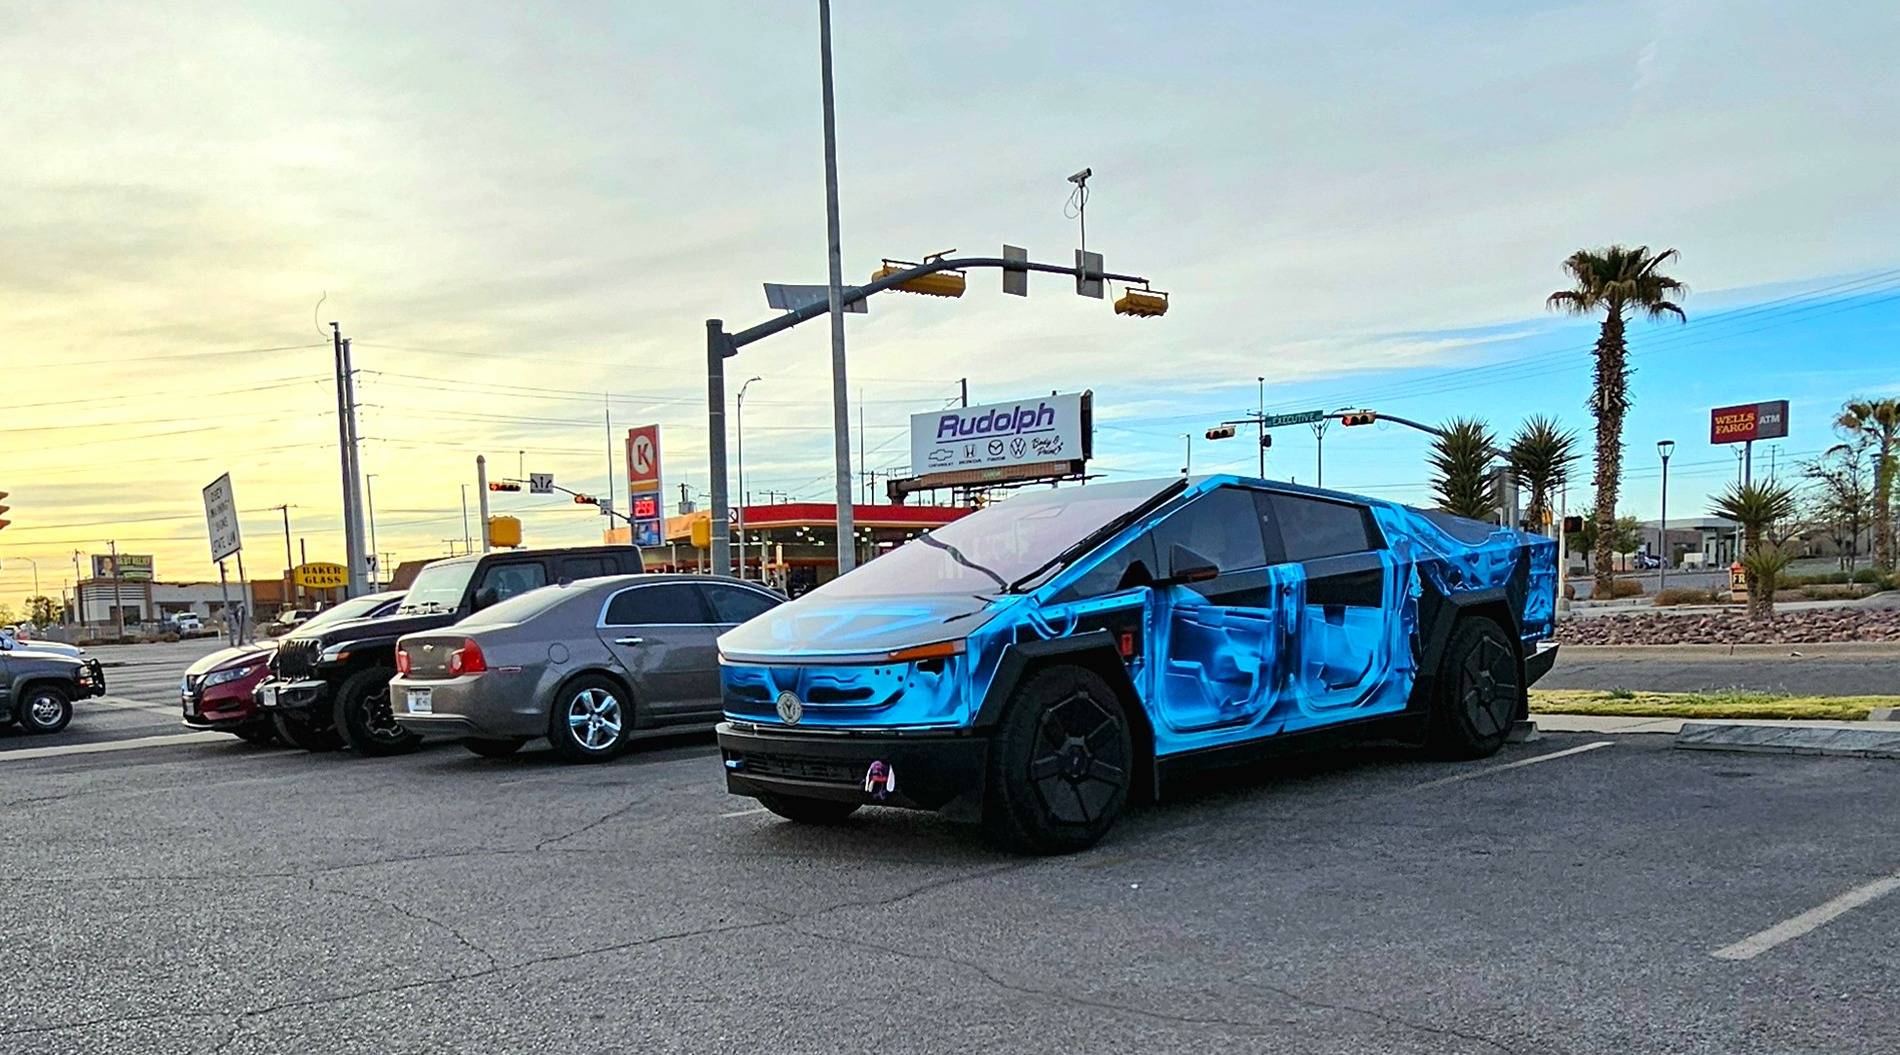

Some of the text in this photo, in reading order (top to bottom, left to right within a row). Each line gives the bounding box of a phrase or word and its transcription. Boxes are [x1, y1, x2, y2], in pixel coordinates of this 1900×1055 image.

[937, 403, 1055, 438] Rudolph
[1272, 412, 1315, 425] EXECUTIVE
[1715, 412, 1755, 425] WELLS
[1759, 414, 1781, 425] ATM
[1715, 422, 1754, 434] FARGO
[302, 566, 341, 574] BAKER
[304, 576, 342, 584] GLASS
